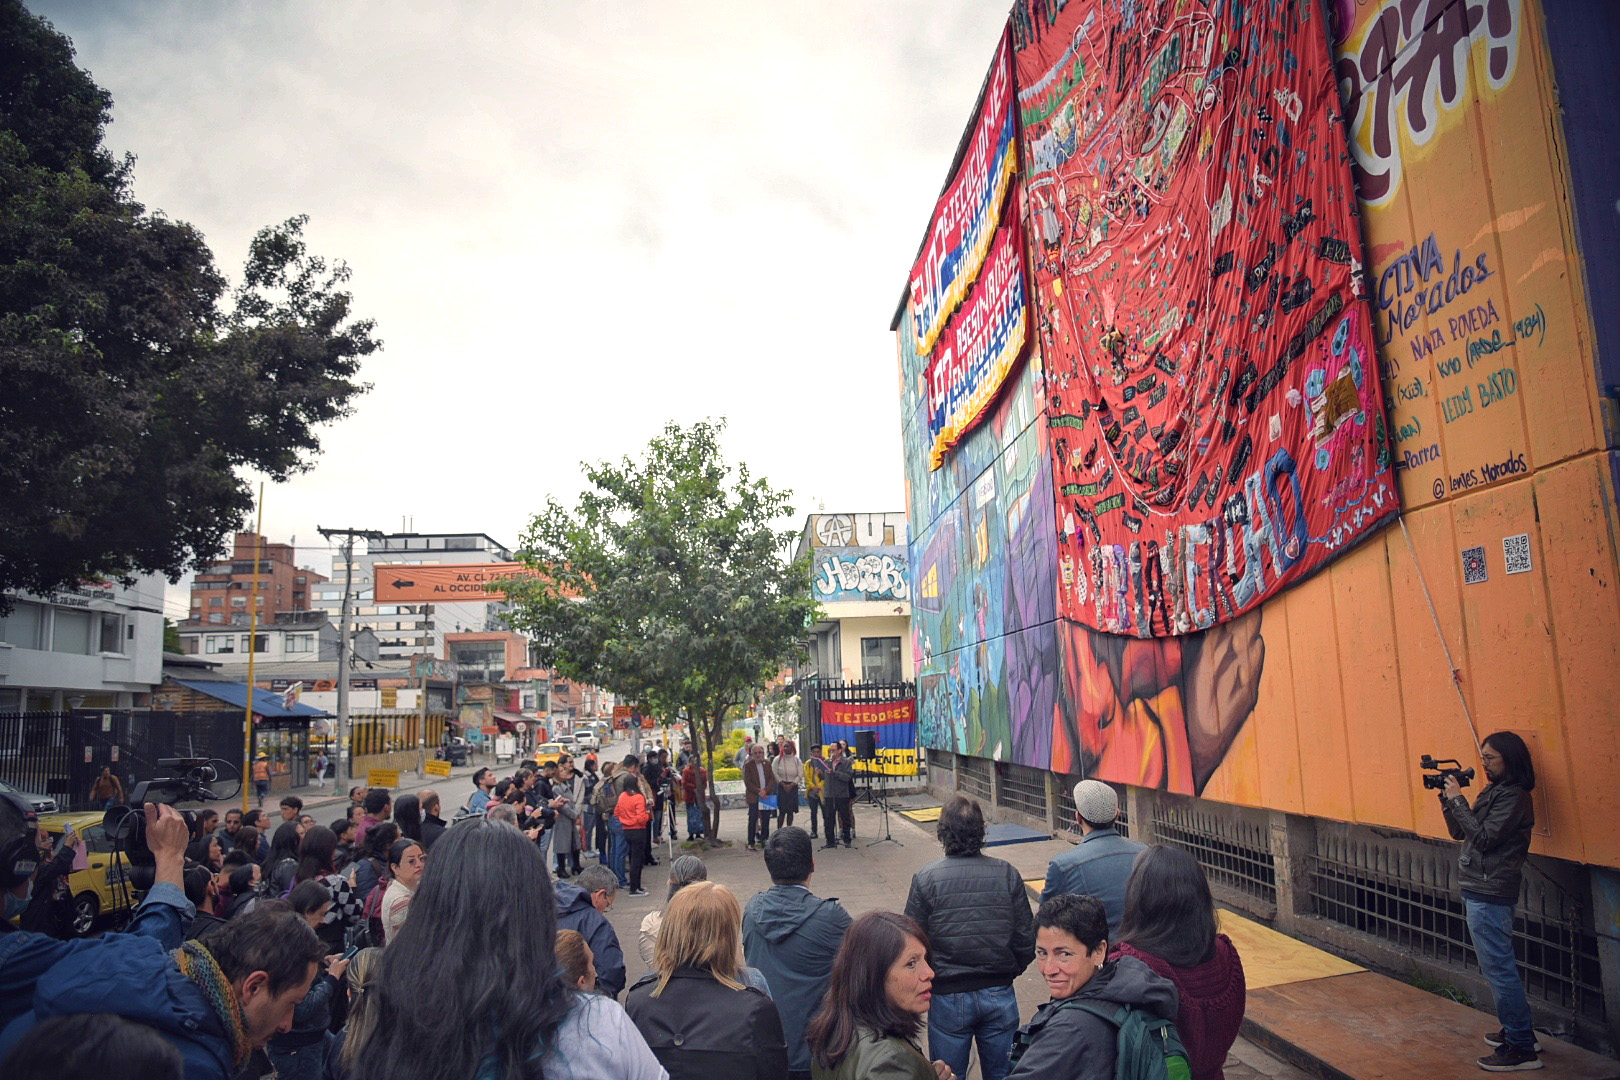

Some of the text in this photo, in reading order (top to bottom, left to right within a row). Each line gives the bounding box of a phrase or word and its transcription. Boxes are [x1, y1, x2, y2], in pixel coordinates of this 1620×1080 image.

[1448, 298, 1500, 341] POVEDA
[457, 573, 471, 582] AV.
[474, 573, 486, 582] CL
[489, 572, 500, 581] 72
[434, 584, 446, 592] AL
[835, 706, 910, 724] TEJEDORES
